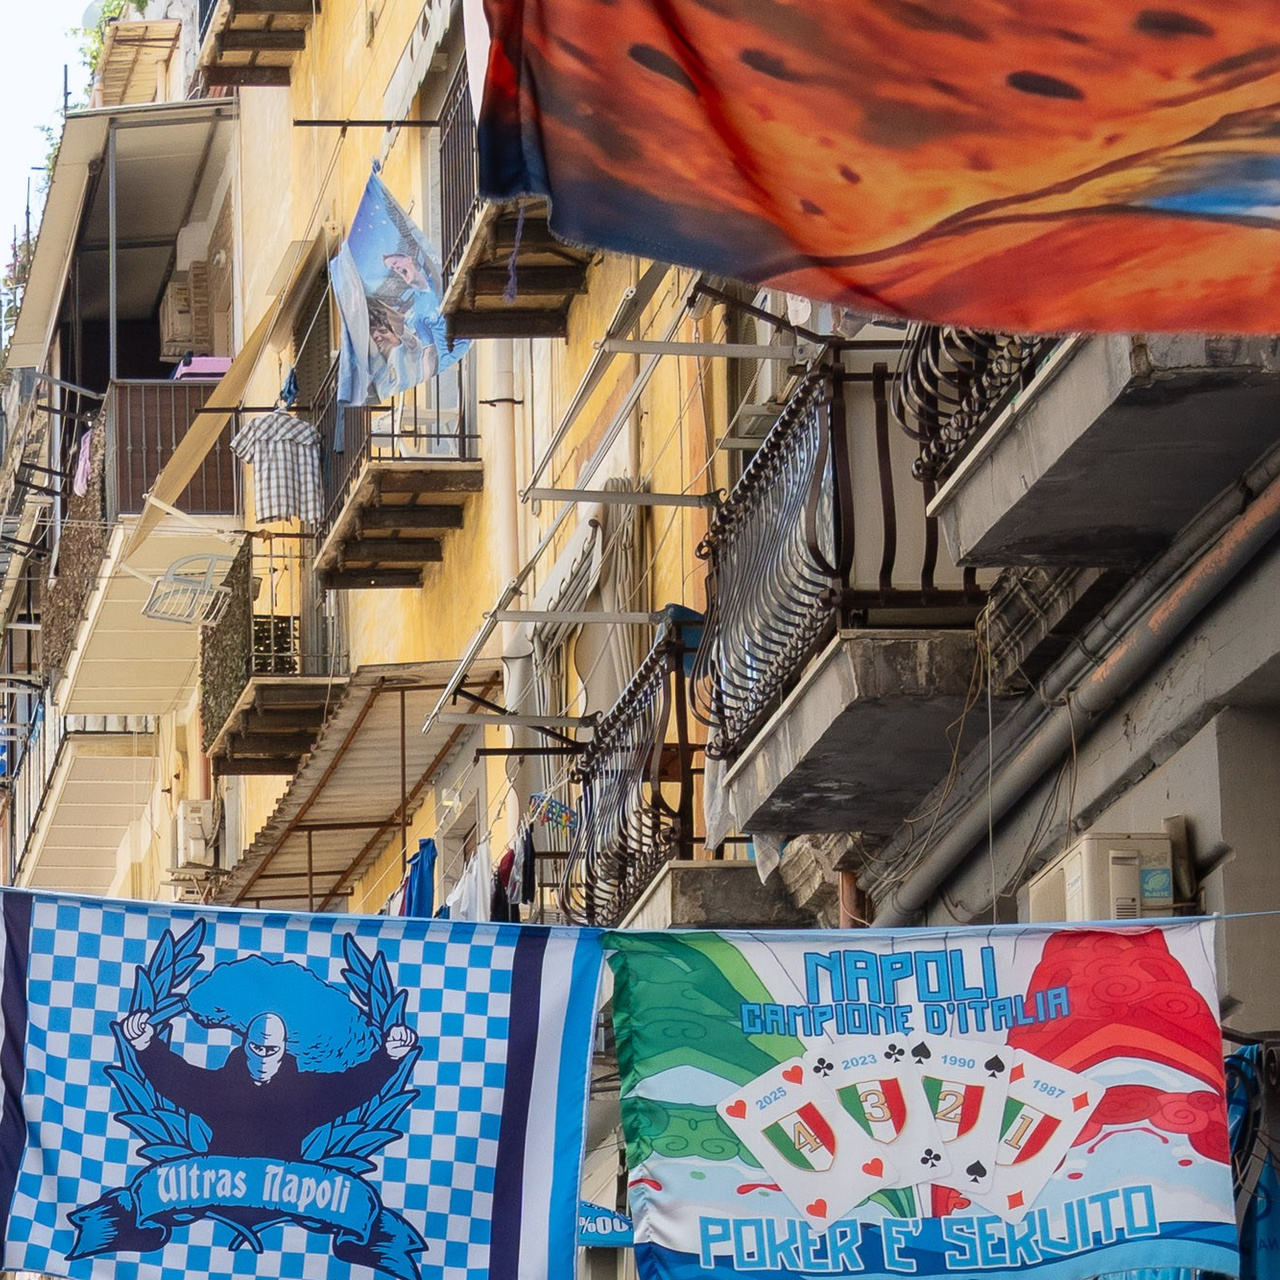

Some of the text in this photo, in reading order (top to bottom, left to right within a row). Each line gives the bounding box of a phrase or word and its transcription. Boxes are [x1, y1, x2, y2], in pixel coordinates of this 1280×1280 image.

[803, 946, 998, 1005] NAPOLI
[740, 985, 1071, 1037] CAMPIONE D'ITALIA
[841, 1054, 878, 1071] 2023
[940, 1054, 976, 1070] 1990
[755, 1086, 788, 1111] 2025
[858, 1089, 892, 1123] 3
[1032, 1079, 1066, 1099] 1987
[936, 1089, 965, 1124] 2
[792, 1120, 824, 1154] 4
[1003, 1113, 1035, 1151] 1
[156, 1163, 351, 1214] Ultras Napoli
[698, 1215, 865, 1272] POKER
[941, 1184, 1161, 1271] SERVITO
